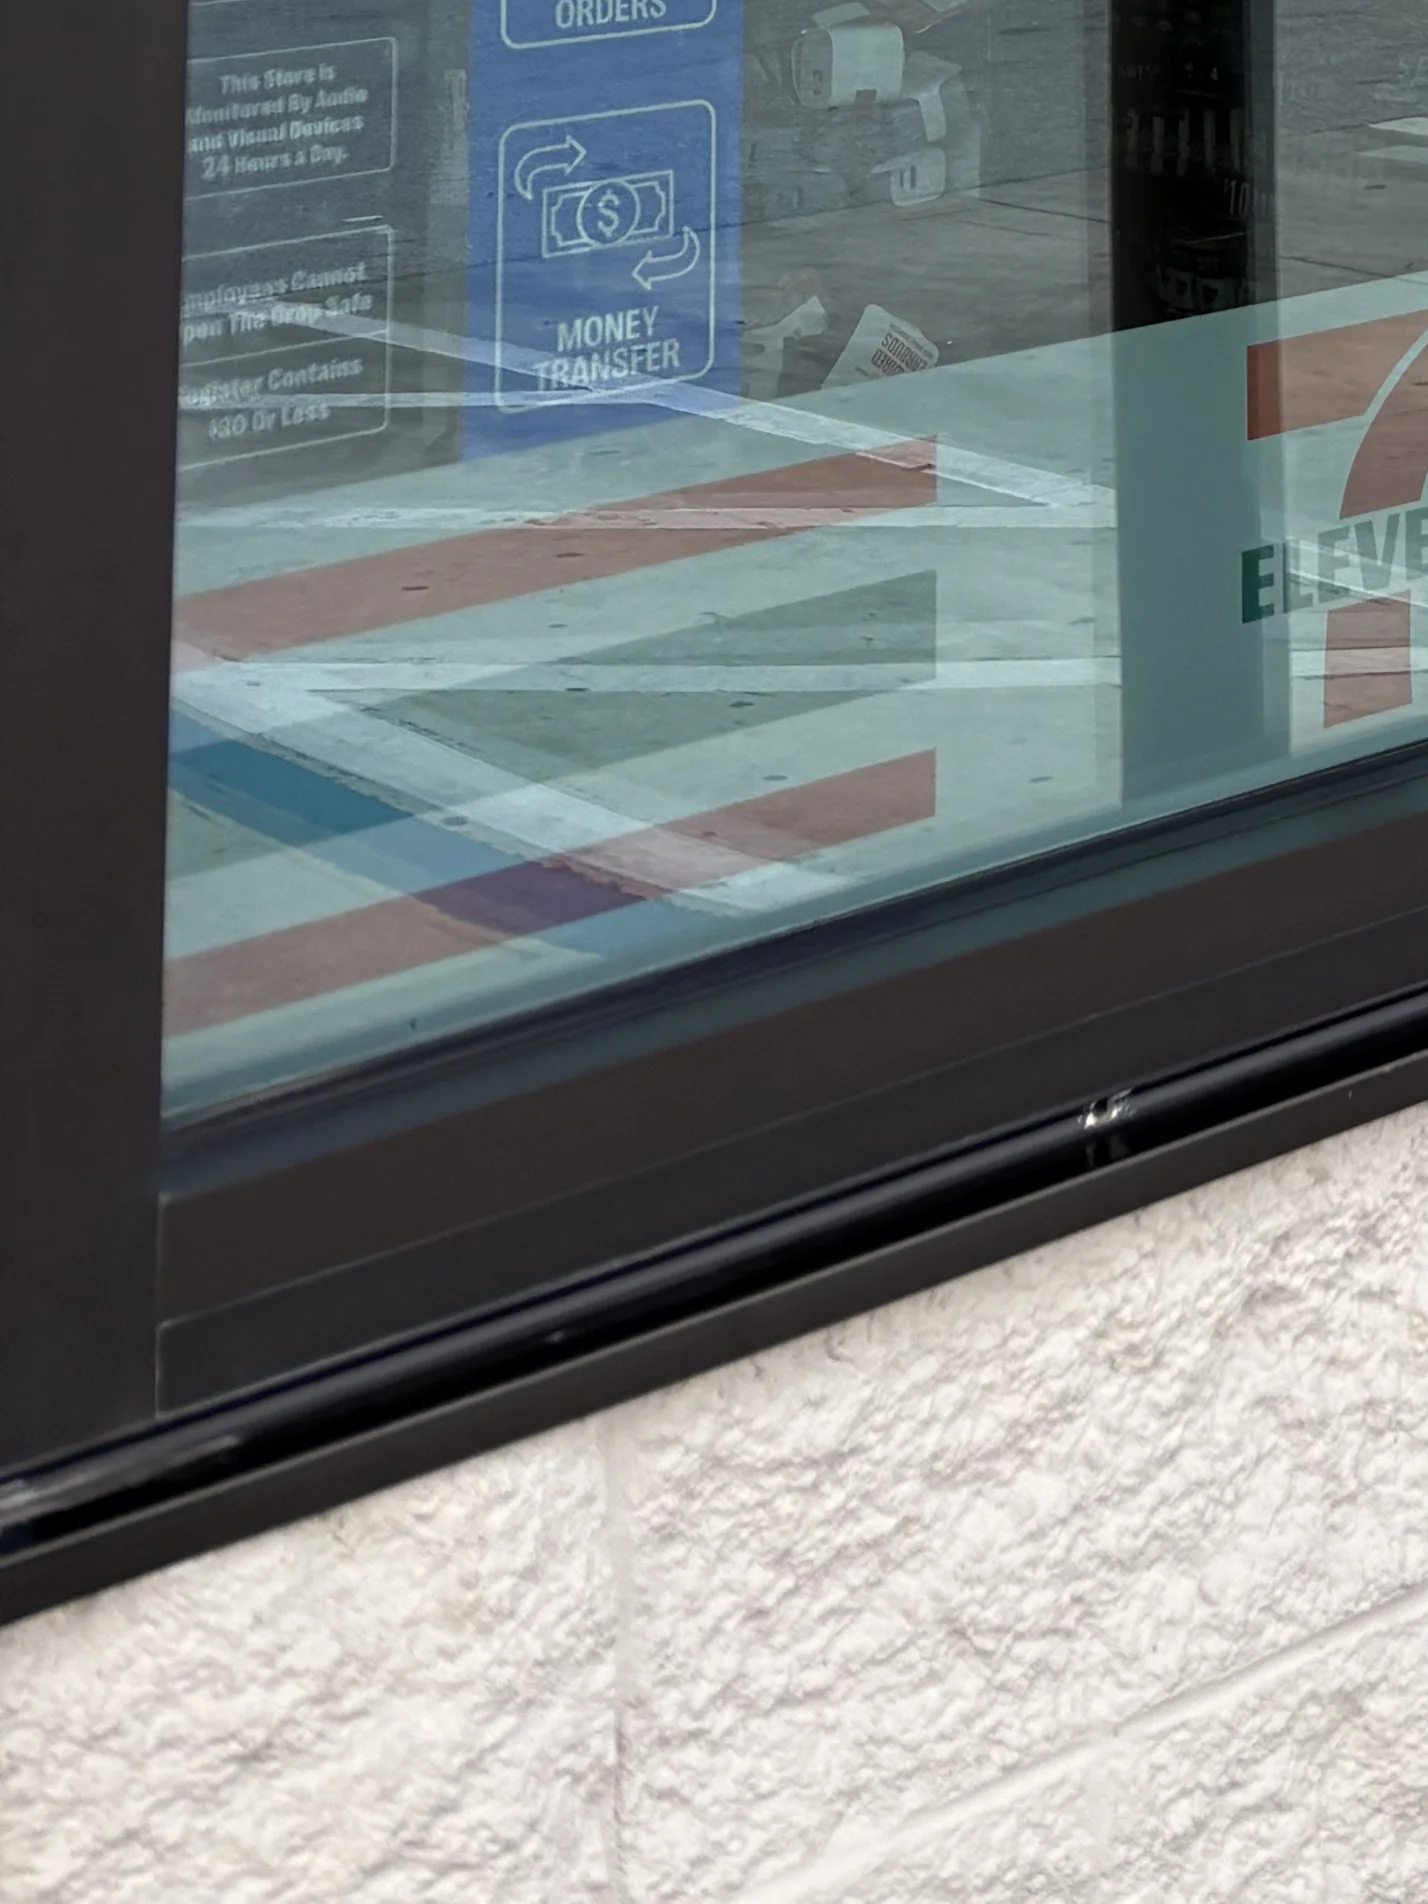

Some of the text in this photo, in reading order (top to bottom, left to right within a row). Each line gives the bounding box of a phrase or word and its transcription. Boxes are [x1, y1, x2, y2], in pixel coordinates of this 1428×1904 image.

[220, 62, 339, 94] This Store is
[287, 92, 313, 115] By
[314, 86, 370, 109] Audio
[201, 144, 350, 180] 24 Hours a Day.
[557, 305, 659, 352] MONEY
[532, 339, 681, 392] TRANSFER
